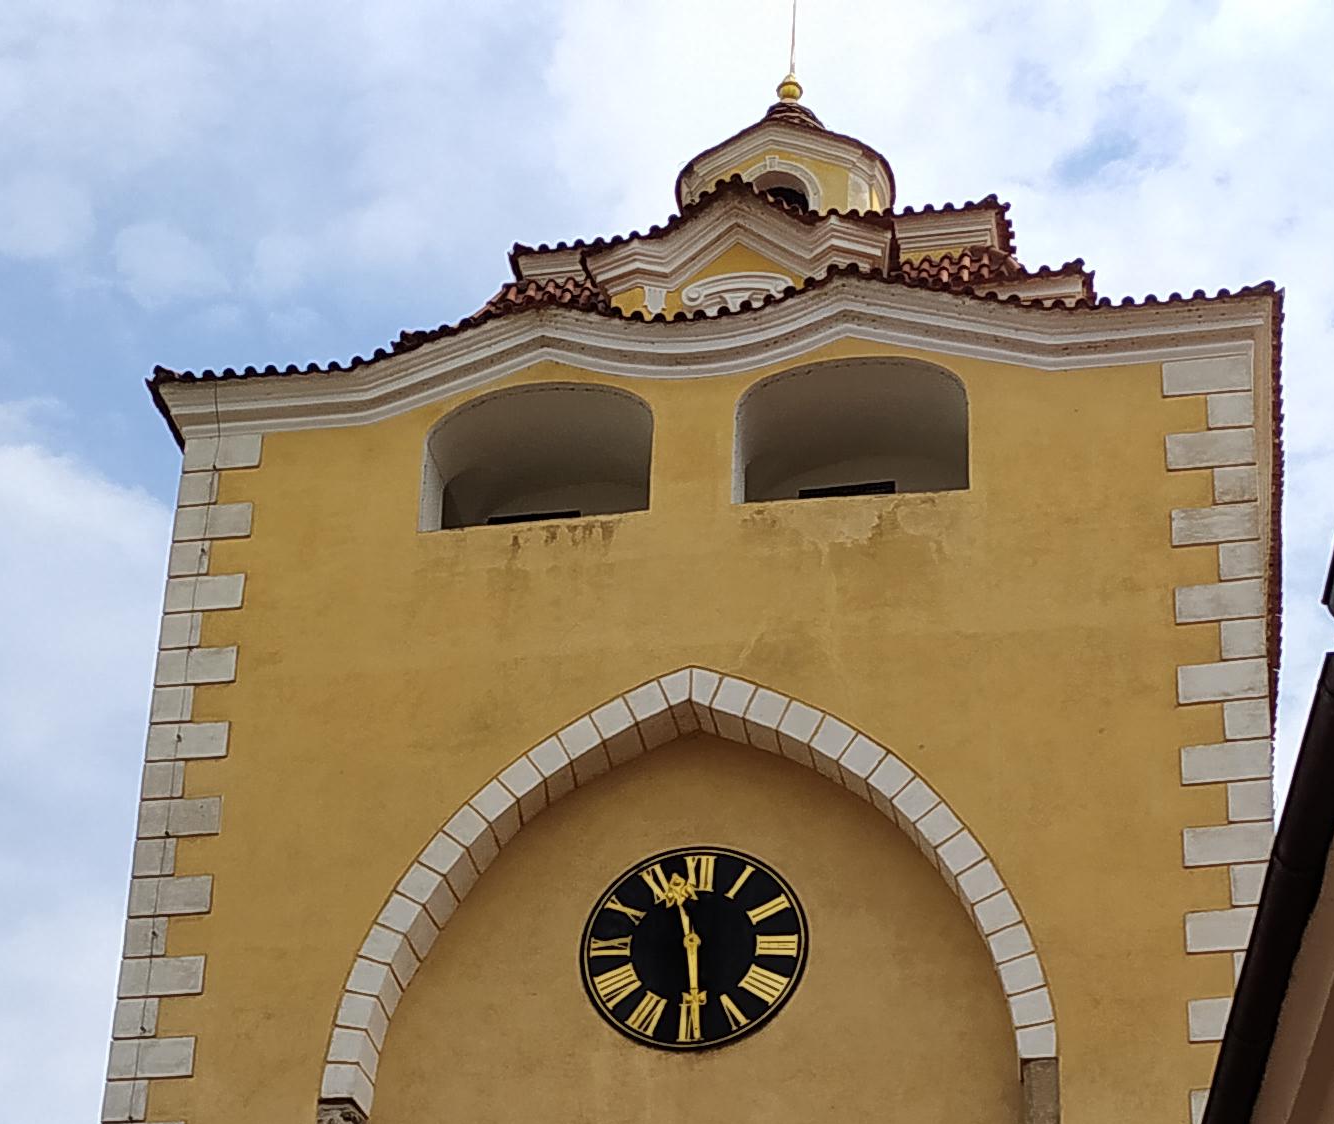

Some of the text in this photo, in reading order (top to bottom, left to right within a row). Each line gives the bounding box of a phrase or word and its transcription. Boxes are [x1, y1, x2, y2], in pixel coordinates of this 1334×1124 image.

[684, 856, 716, 892] XII
[724, 864, 756, 899] I
[603, 895, 647, 926] X
[746, 893, 791, 925] II
[590, 934, 632, 958] IX
[755, 934, 798, 957] III
[593, 962, 642, 1010] VIII
[624, 990, 667, 1037] VII
[720, 994, 751, 1030] V
